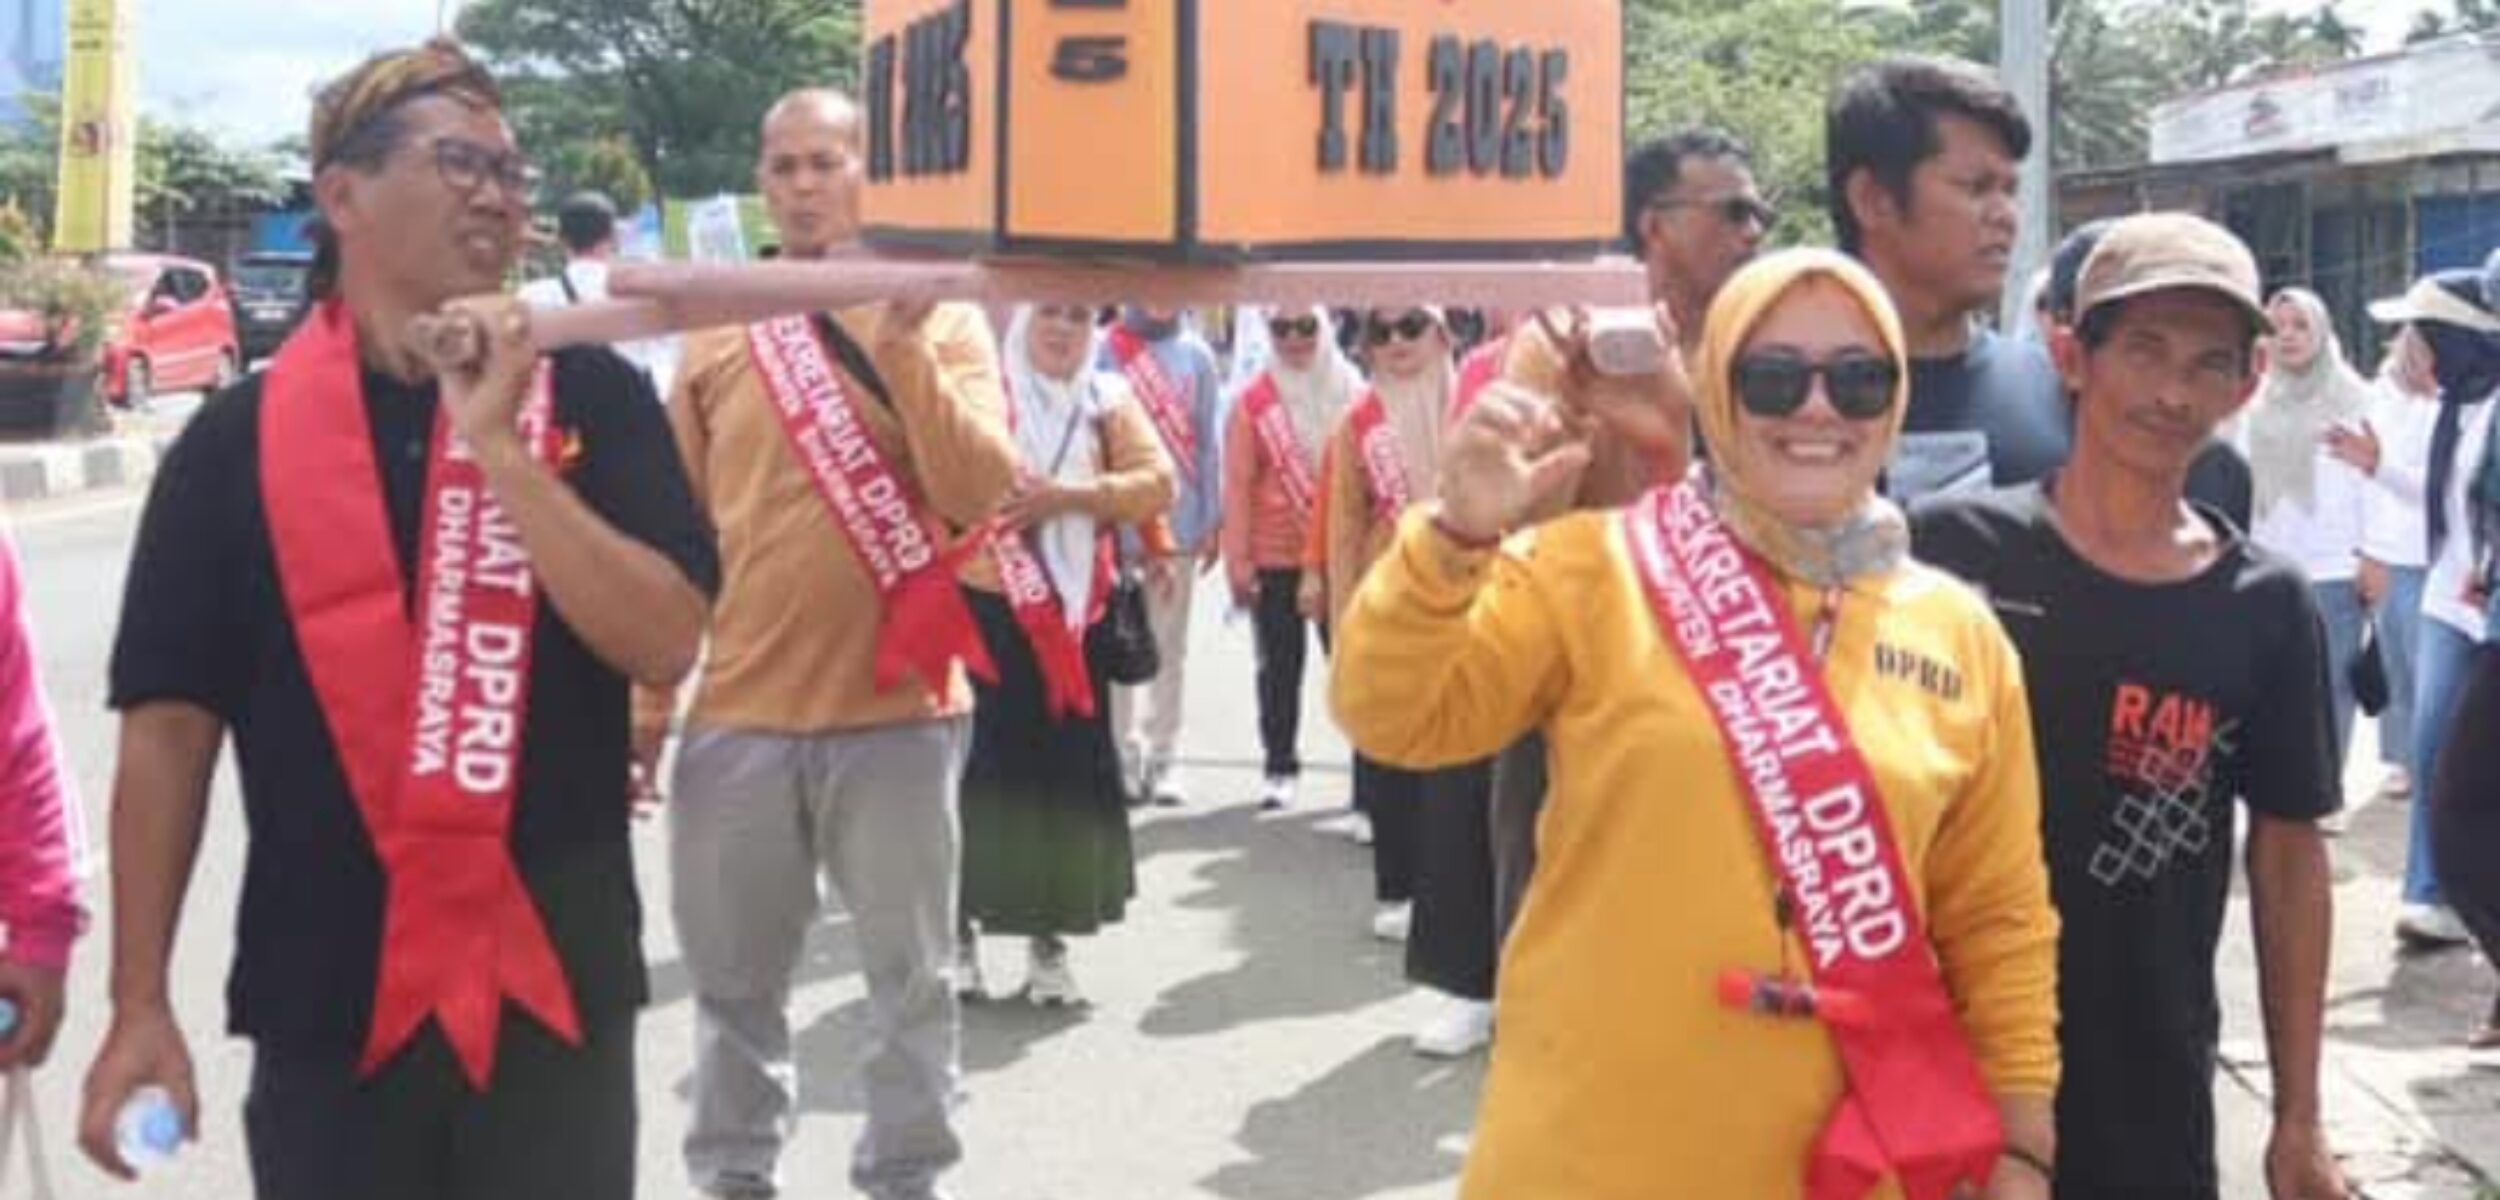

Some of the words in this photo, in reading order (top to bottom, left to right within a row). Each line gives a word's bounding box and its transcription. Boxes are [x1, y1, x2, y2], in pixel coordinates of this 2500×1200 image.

[1048, 35, 1128, 84] 5
[1424, 33, 1568, 181] 2025
[858, 473, 933, 572] DPRD
[411, 485, 474, 777] DHARMASRAYA
[454, 621, 523, 795] DPRD
[1874, 641, 1962, 701] DPRD
[1663, 481, 1841, 759] SEKRETARIAT
[1804, 780, 1906, 960] DPRD
[1706, 678, 1847, 969] DHARMASRAYA
